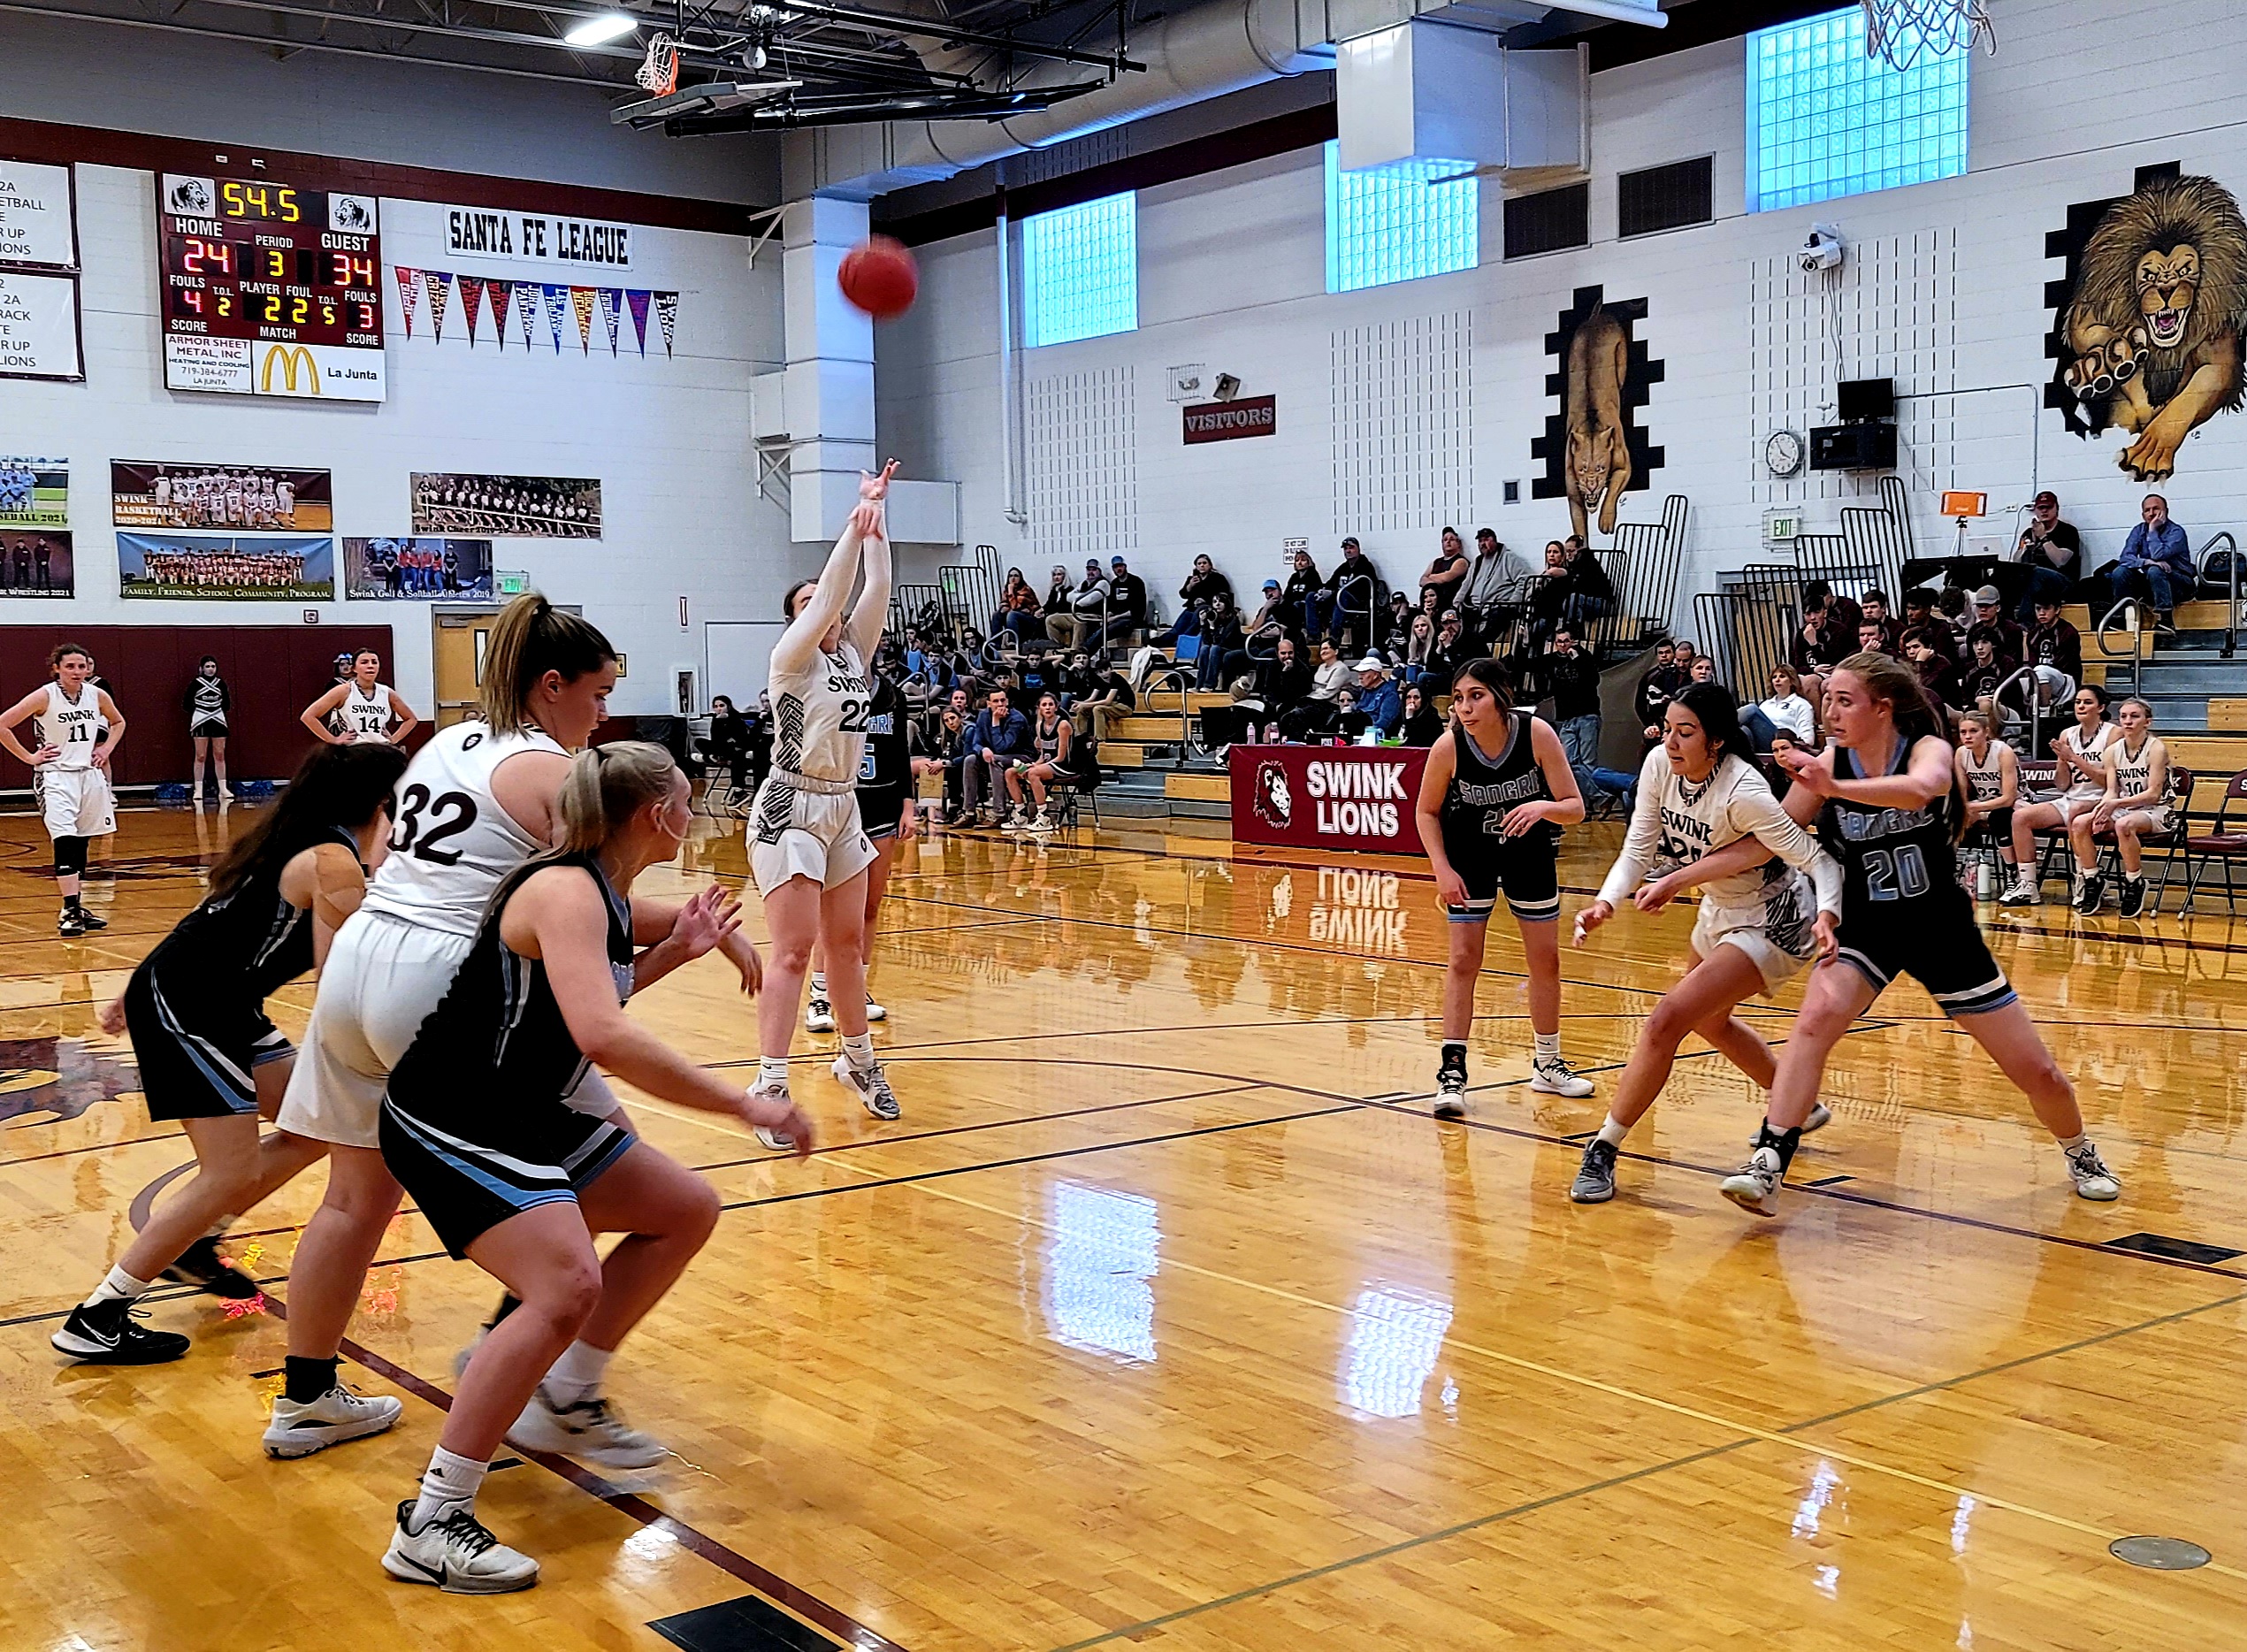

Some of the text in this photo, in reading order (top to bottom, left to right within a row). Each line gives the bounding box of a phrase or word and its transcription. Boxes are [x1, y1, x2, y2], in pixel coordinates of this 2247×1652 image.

[0, 196, 46, 210] ETBALL
[224, 183, 299, 222] 54.5
[8, 228, 26, 238] UP
[176, 218, 223, 237] HOME
[256, 234, 294, 249] PERIOD
[321, 233, 370, 252] GUEST
[449, 210, 629, 265] SANTA FE LEAGUE
[184, 239, 229, 272] 24
[269, 251, 284, 276] 3
[332, 254, 372, 287] 34
[170, 274, 205, 288] FOULS
[240, 281, 313, 298] PLAYER FOUL
[345, 290, 377, 303] FOULS
[555, 287, 568, 305] LAS
[4, 294, 21, 305] 2A
[184, 290, 203, 313] 4
[218, 296, 231, 317] 2
[0, 310, 31, 321] RACK
[359, 304, 373, 329] 3
[171, 319, 208, 333] SCORE
[260, 326, 296, 340] MATCH
[12, 340, 30, 351] UP
[169, 336, 248, 349] ARMOR SHEET
[346, 333, 378, 346] SCORE
[221, 350, 241, 359] INC
[327, 367, 377, 380] La Junta
[1186, 407, 1273, 432] VISITORS
[114, 494, 149, 504] SWINK
[0, 513, 38, 522] SEBALL
[115, 505, 181, 516] BASKETBALL
[1774, 519, 1793, 537] EXIT
[349, 589, 375, 598] Swink
[57, 710, 96, 723] SWINK
[352, 704, 386, 715] SWINK
[838, 699, 870, 733] 22
[68, 723, 89, 742] 11
[359, 716, 380, 733] 14
[1307, 761, 1408, 799] SWINK
[2025, 769, 2058, 781] WIN
[2115, 768, 2150, 778] SWINK
[386, 783, 478, 866] 32
[1317, 800, 1399, 837] LIONS
[1661, 806, 1714, 846] SWINK
[1861, 844, 1930, 901] 20
